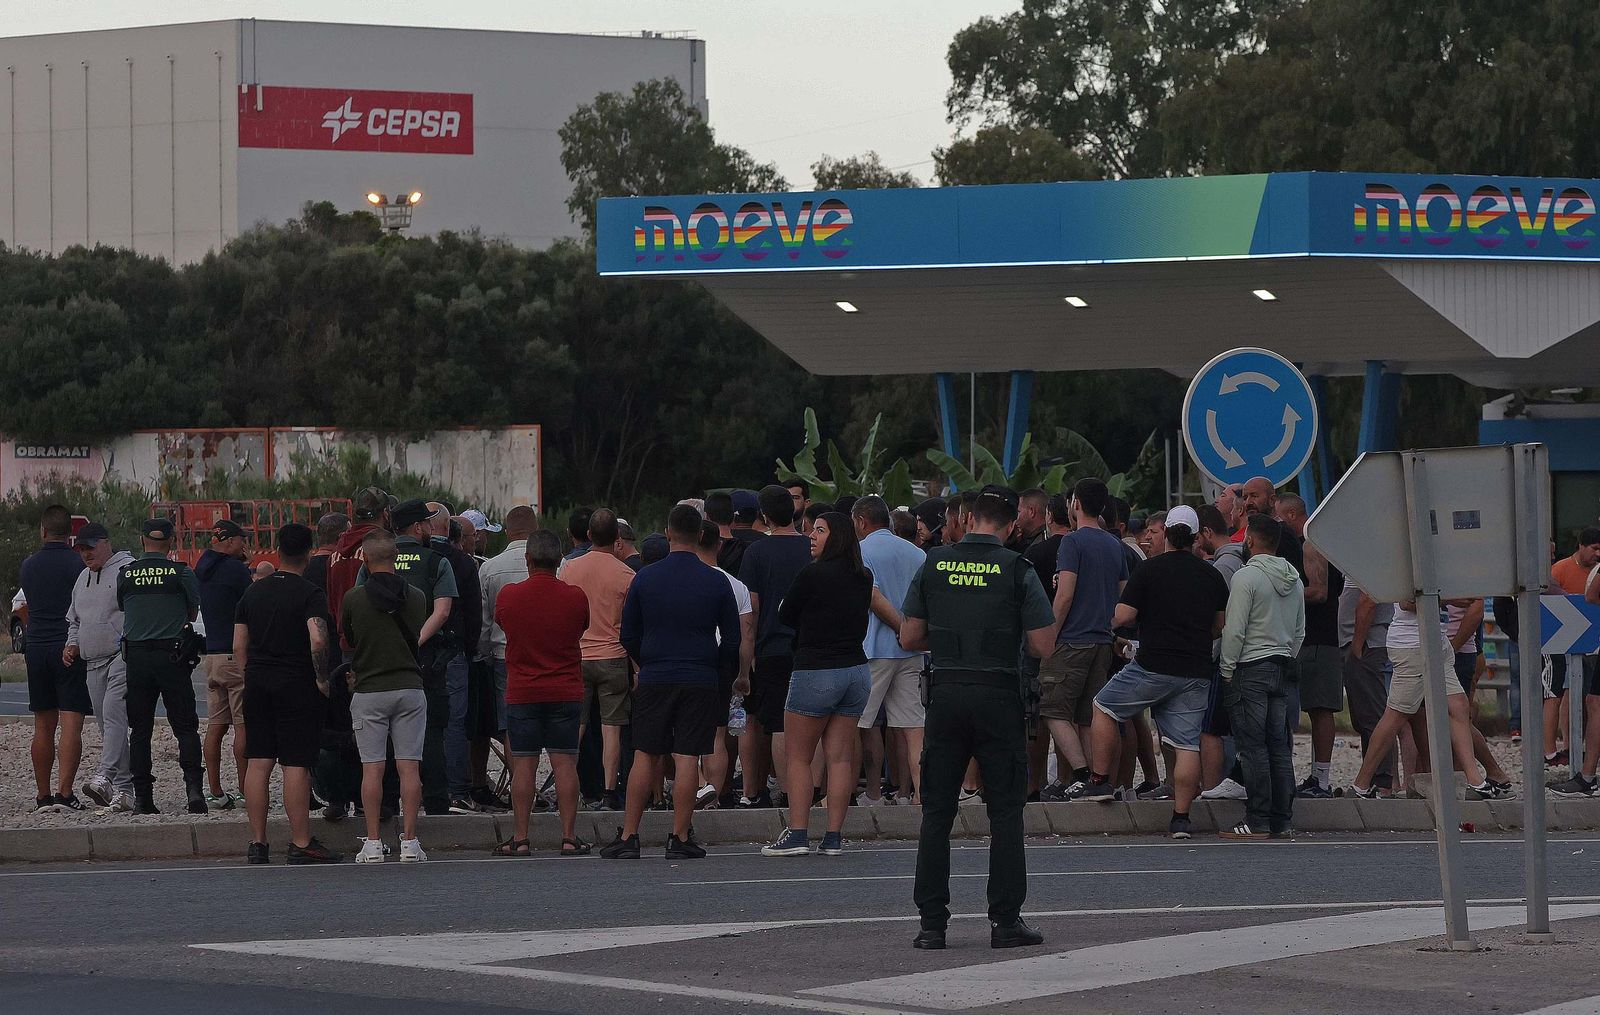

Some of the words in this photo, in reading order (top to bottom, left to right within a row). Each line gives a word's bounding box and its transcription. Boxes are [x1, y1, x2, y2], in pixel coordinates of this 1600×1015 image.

[368, 108, 460, 137] CEPSA
[1354, 183, 1597, 249] moeve
[634, 198, 853, 263] moeve
[16, 446, 89, 457] OBRAMAT
[394, 562, 411, 570] VIL
[936, 561, 1001, 573] GUARDIA
[125, 567, 176, 578] GUARDIA
[134, 576, 164, 585] CIVIL
[948, 574, 987, 586] CIVIL
